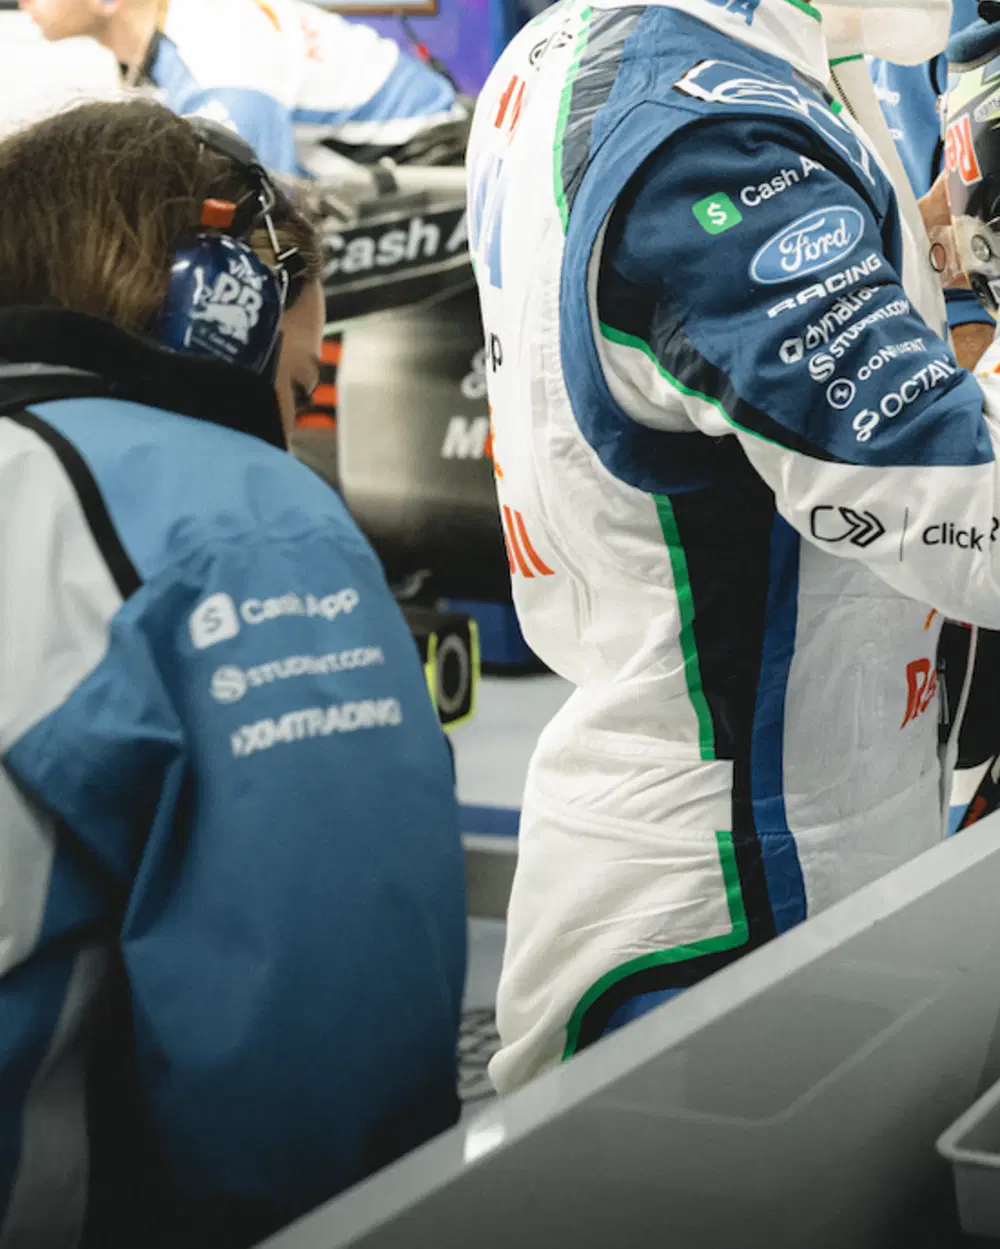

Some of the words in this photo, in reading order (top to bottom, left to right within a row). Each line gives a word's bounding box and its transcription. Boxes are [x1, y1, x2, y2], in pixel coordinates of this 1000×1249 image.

[740, 168, 799, 206] Cash
[778, 217, 851, 273] Ford
[805, 286, 880, 348] dynatra
[922, 522, 983, 552] Click
